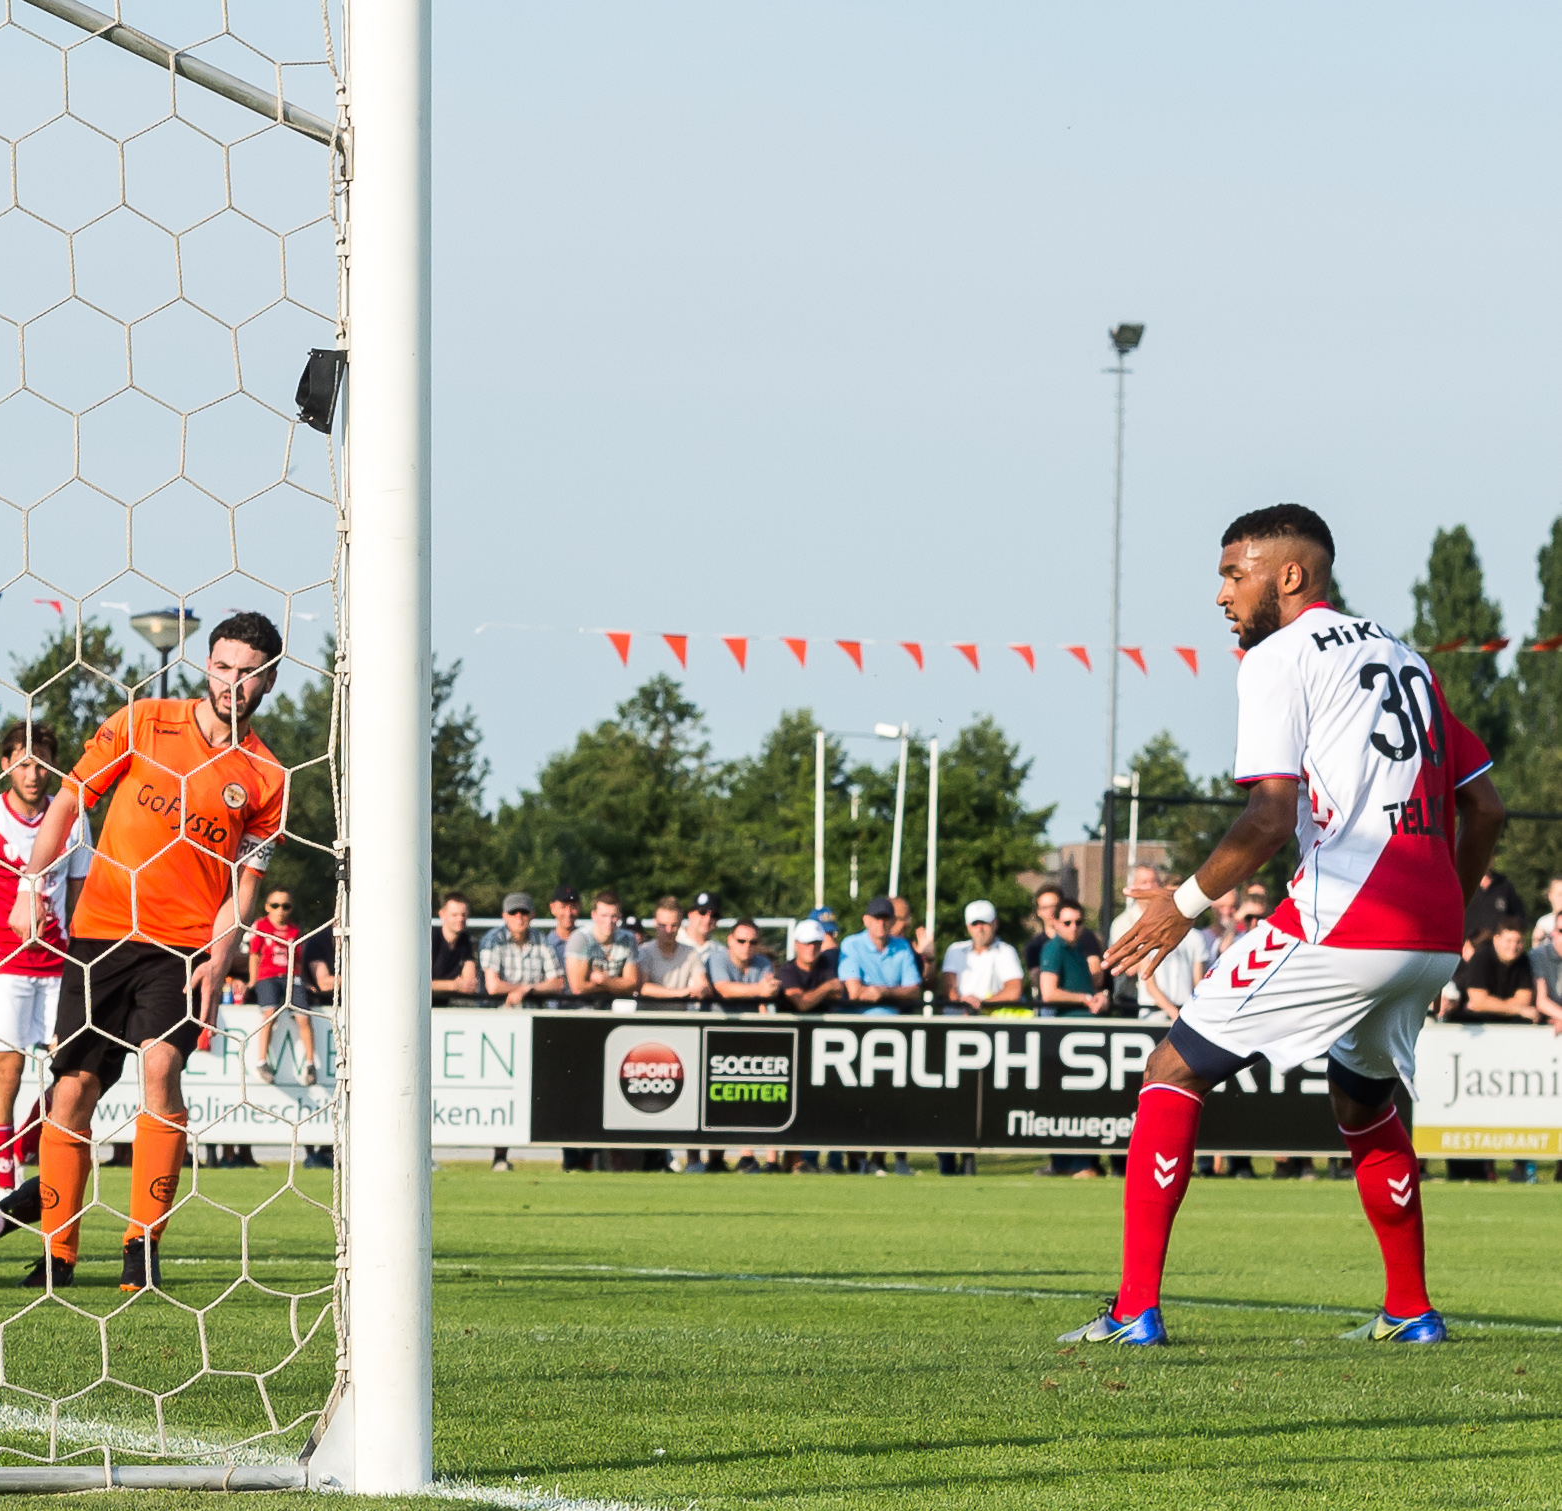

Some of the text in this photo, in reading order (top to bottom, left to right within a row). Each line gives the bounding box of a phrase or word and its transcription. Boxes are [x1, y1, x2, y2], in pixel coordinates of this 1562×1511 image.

[1360, 663, 1445, 767] 30
[137, 784, 228, 843] GoFysio
[710, 1055, 789, 1075] SOCCER
[811, 1028, 1040, 1089] RALPH
[623, 1062, 681, 1078] SPORT
[627, 1078, 676, 1094] 2000
[1443, 1053, 1557, 1108] Jasmi
[709, 1083, 787, 1102] CENTER
[1441, 1131, 1550, 1150] RESTAURANT
